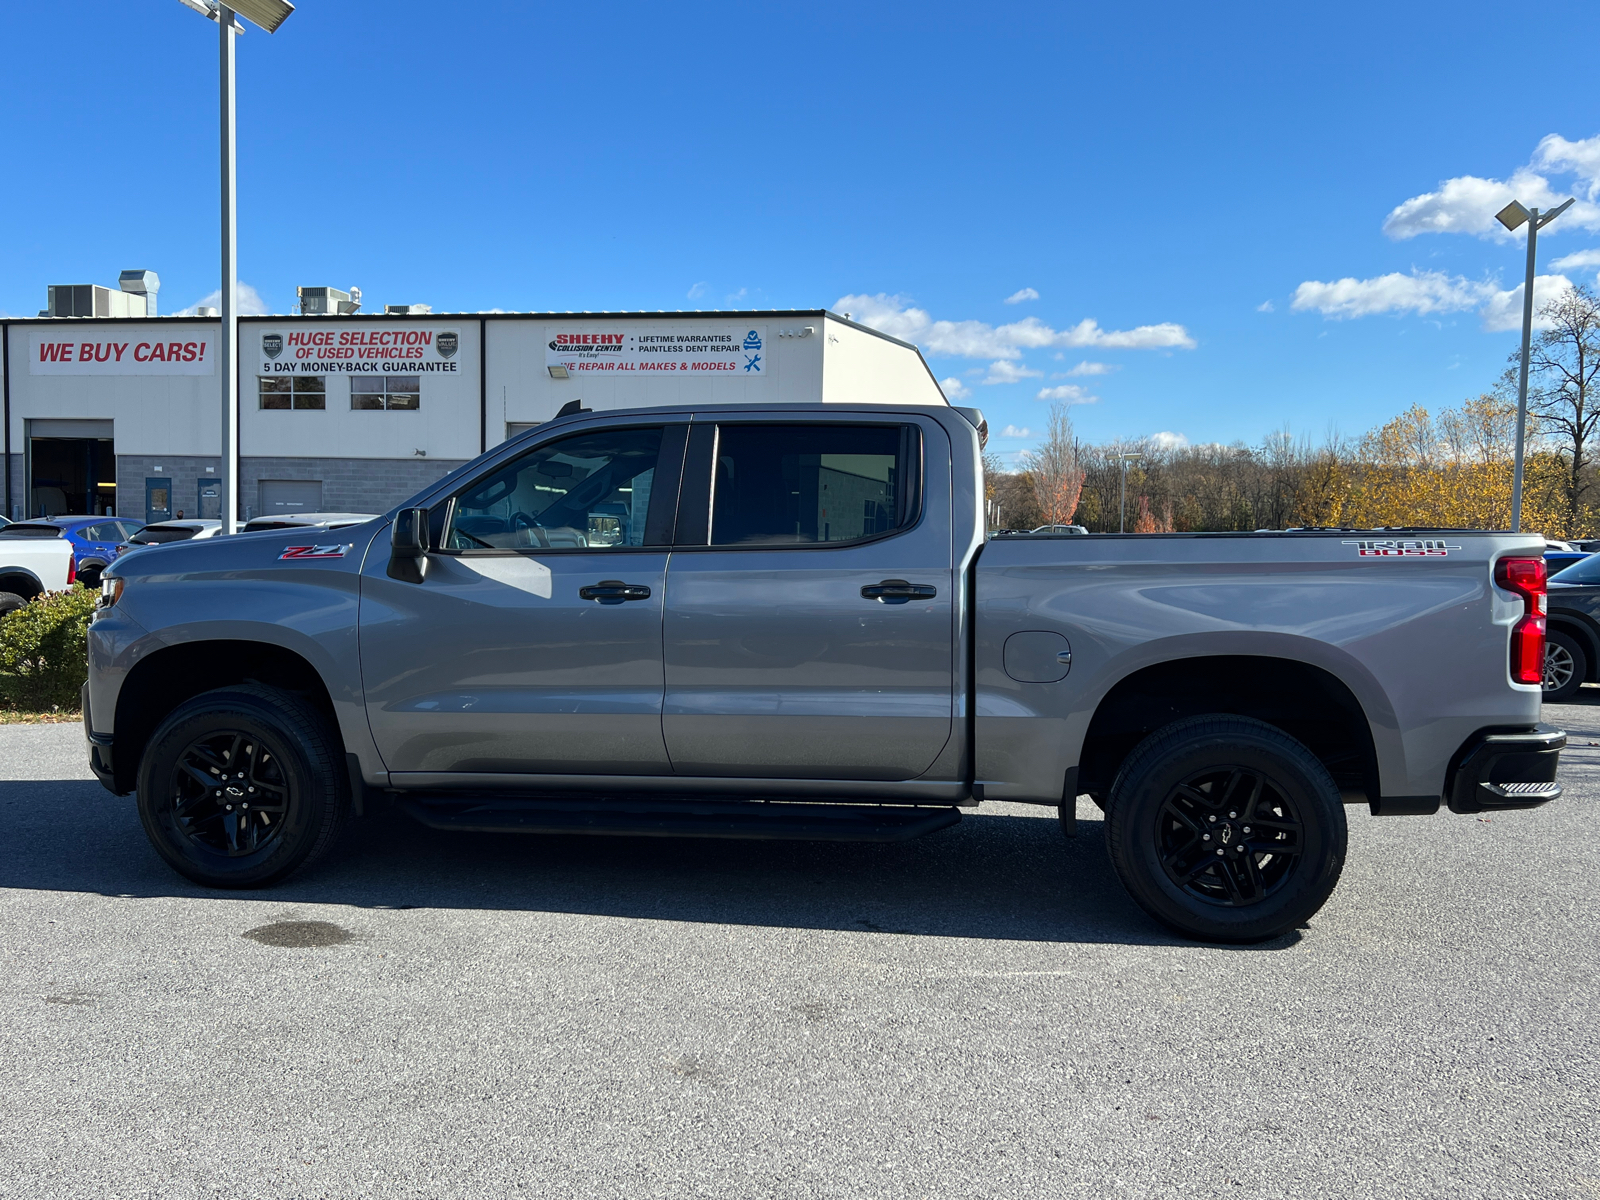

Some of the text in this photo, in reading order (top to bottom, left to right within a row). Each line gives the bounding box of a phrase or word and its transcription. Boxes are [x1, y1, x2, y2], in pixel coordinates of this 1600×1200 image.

[288, 331, 433, 346] HUGE SELECTION
[556, 334, 624, 344] SHEEHY
[676, 335, 732, 343] WARRANTIES
[40, 342, 206, 362] WE BUY CARS!
[295, 347, 424, 359] OF USED VEHICLES
[638, 345, 684, 353] PAINTLESS
[264, 362, 457, 372] 5 DAY MONEY-BACK GUARANTEE
[578, 362, 615, 371] REPAIR
[617, 362, 636, 371] ALL
[639, 362, 677, 371] MAKES
[679, 362, 688, 371] &
[691, 362, 736, 371] MODELS
[1342, 540, 1461, 550] TRAIL
